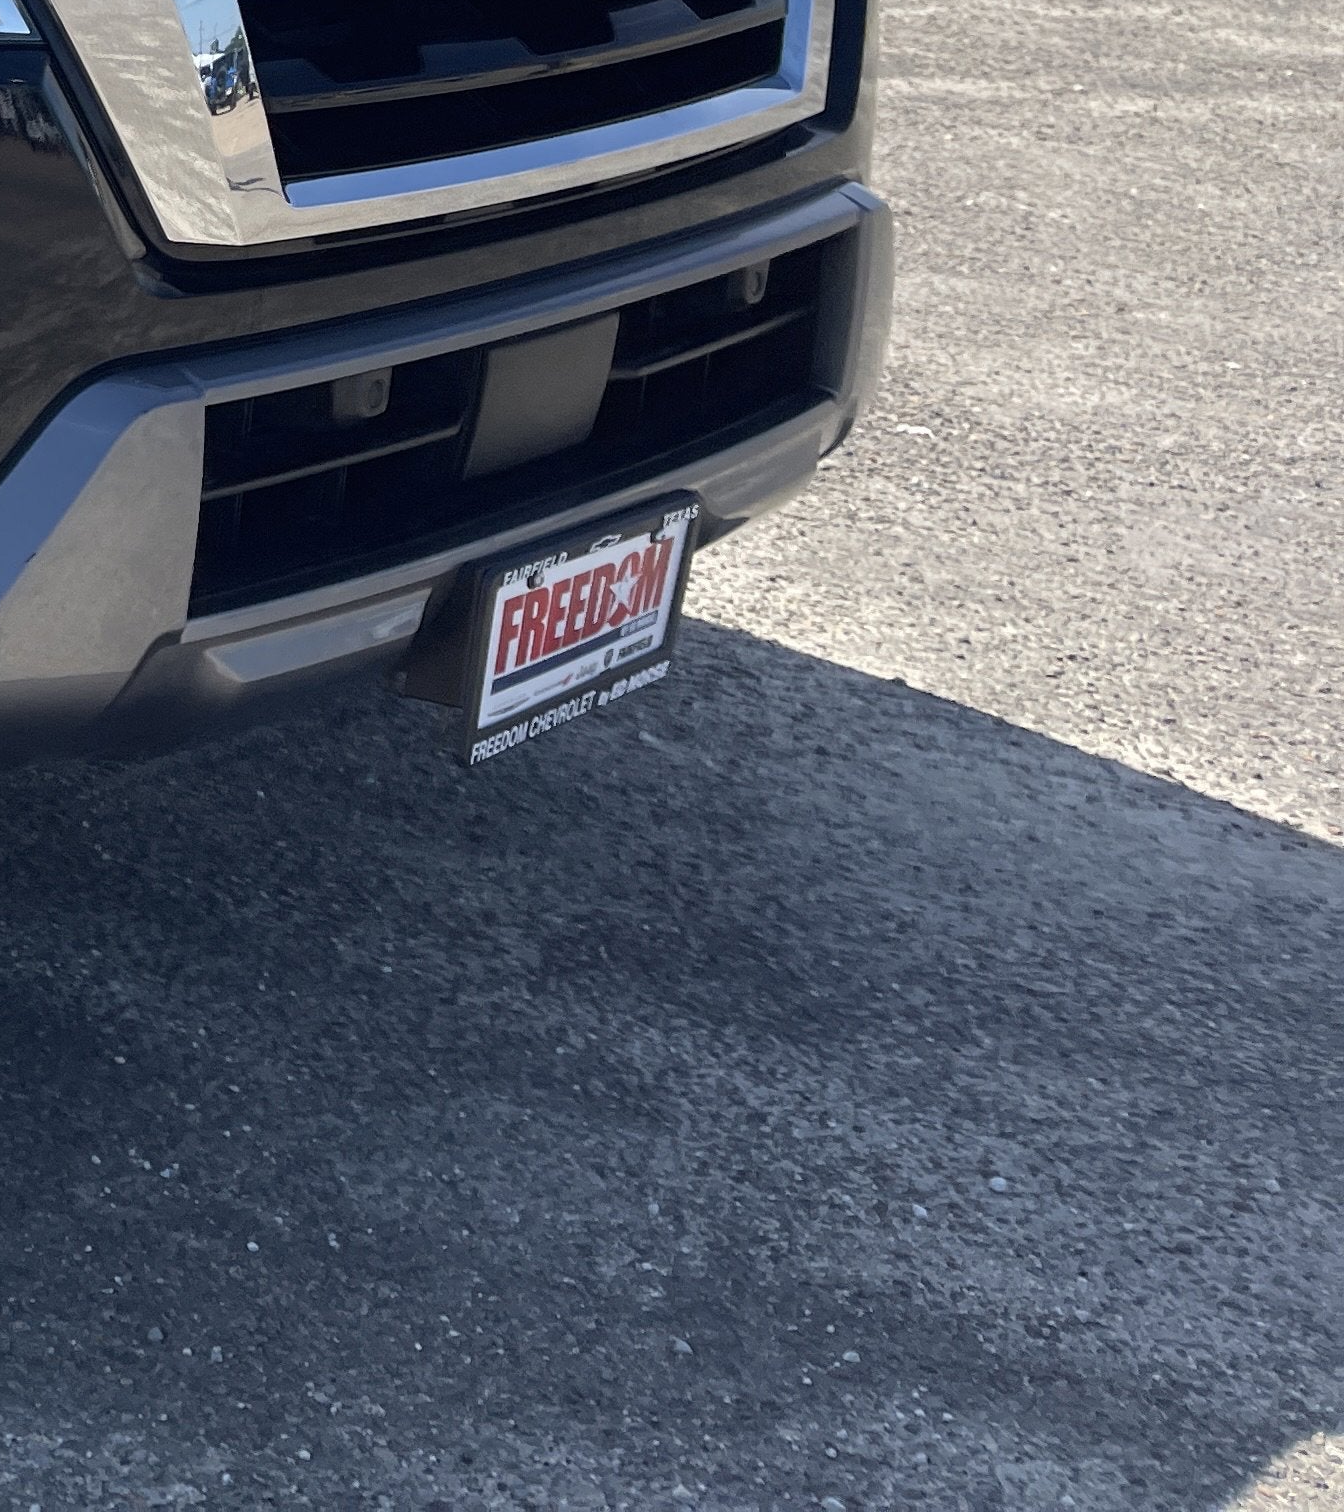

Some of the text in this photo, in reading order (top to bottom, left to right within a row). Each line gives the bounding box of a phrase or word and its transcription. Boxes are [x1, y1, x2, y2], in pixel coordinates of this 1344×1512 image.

[503, 504, 700, 586] FAIRFIELD TEXAS
[494, 537, 675, 676] FREEDOM
[470, 721, 529, 766] FREEDOM
[529, 690, 596, 738] CHEVROLET
